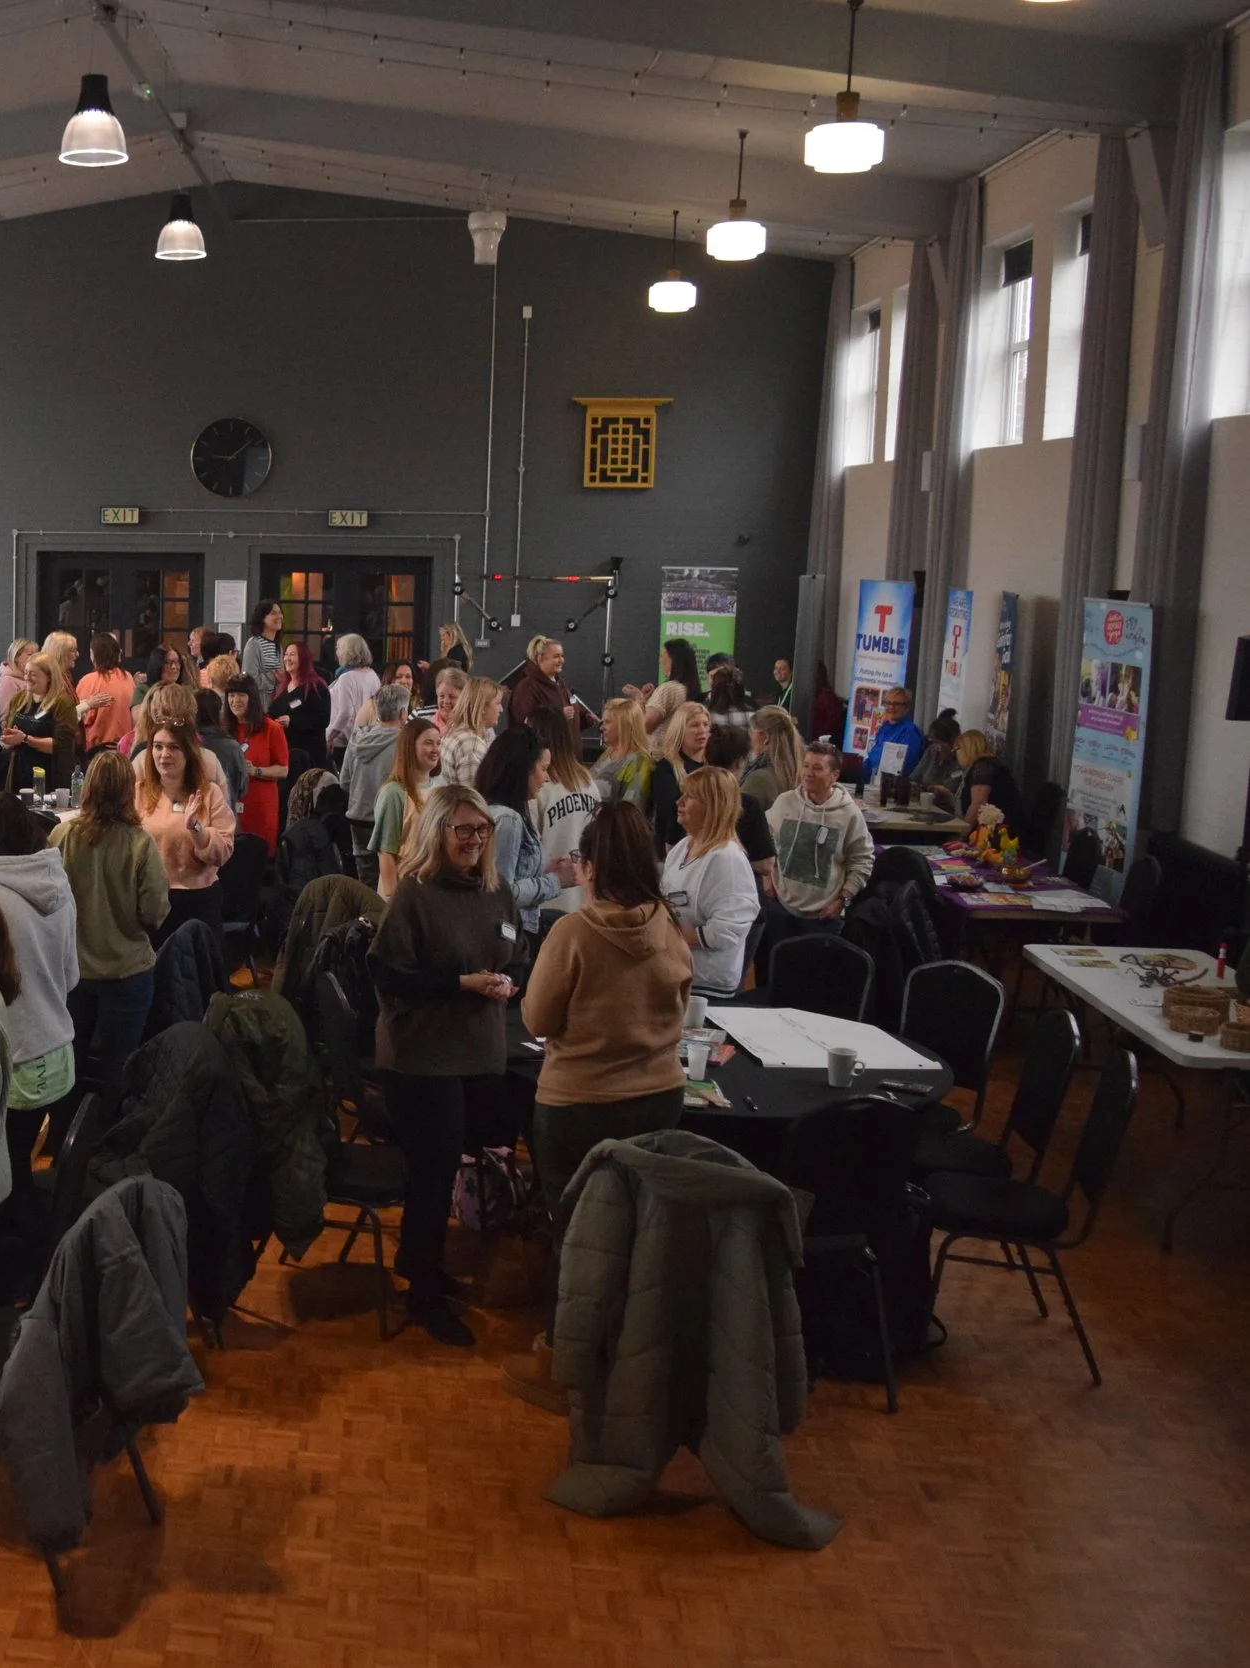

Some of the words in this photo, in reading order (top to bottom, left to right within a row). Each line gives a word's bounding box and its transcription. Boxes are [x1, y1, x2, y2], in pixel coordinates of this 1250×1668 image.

[102, 509, 137, 522] EXIT
[330, 511, 365, 525] EXIT
[874, 604, 893, 633] T
[665, 621, 710, 638] RISE.
[856, 633, 906, 656] TUMBLE
[547, 793, 596, 828] PHOENI
